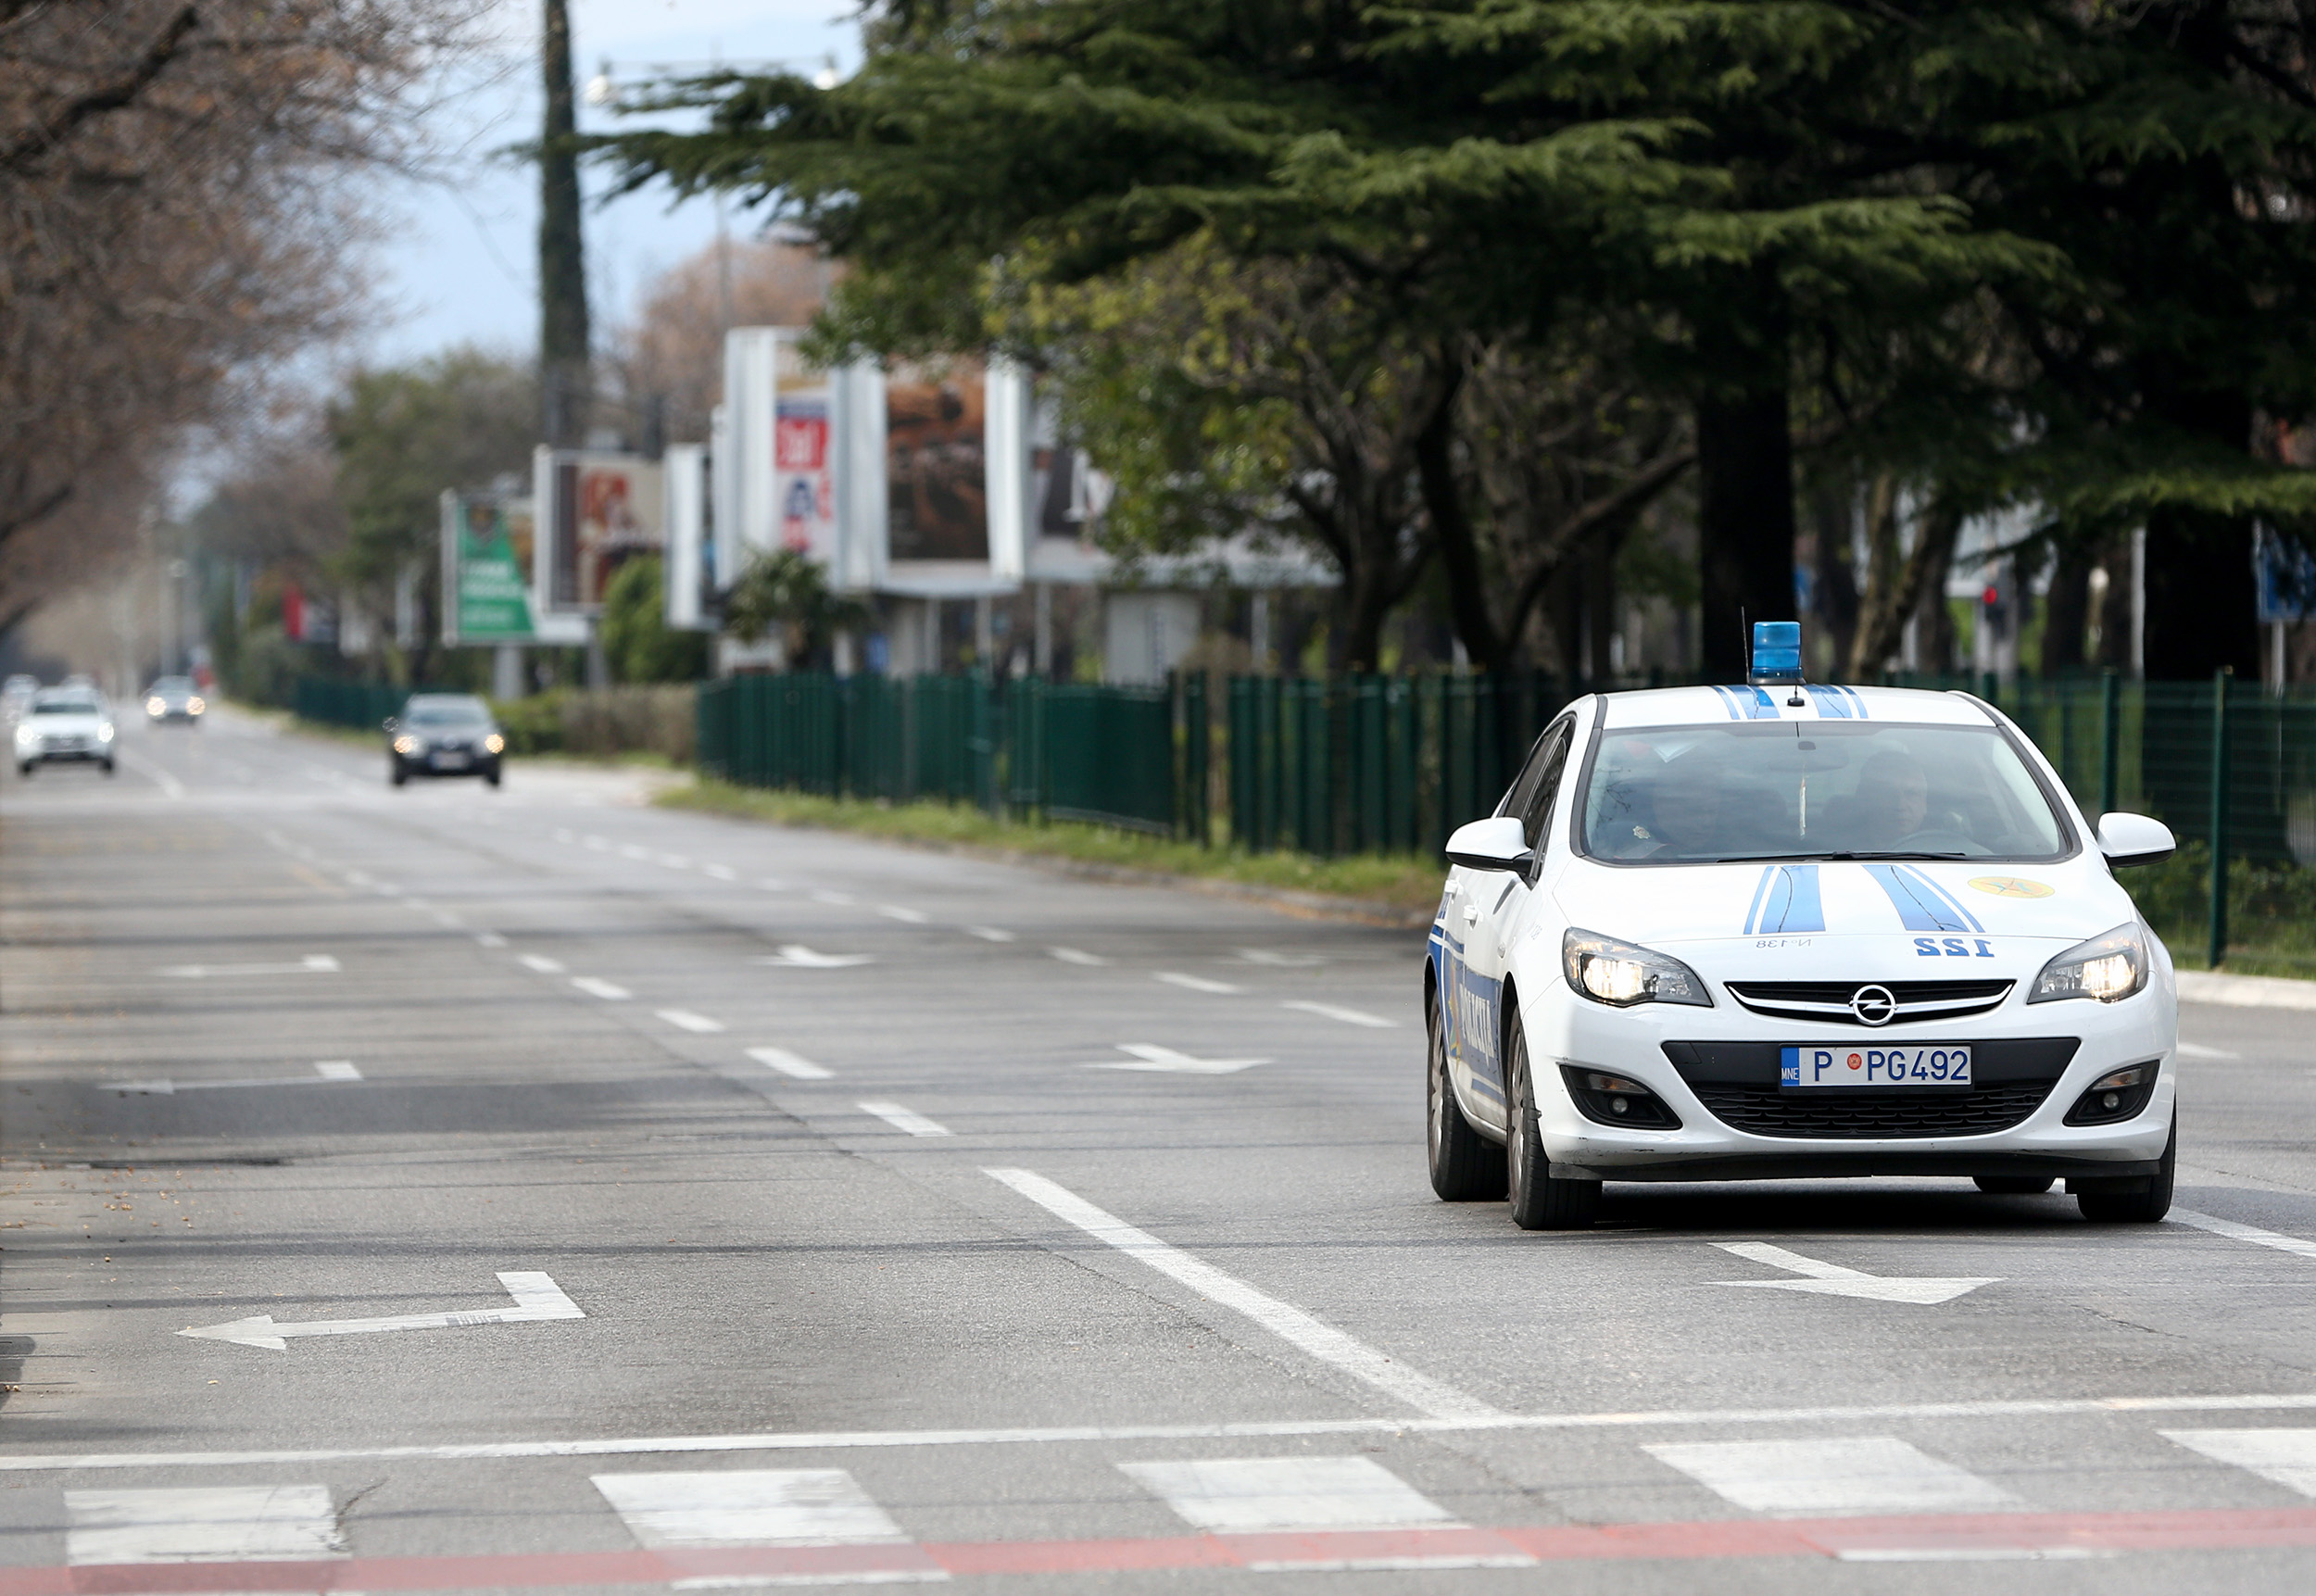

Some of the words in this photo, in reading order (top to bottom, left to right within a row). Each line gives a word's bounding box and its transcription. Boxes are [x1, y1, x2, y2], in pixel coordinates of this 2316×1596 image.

[1781, 1067, 1800, 1081] MNE
[1814, 1051, 1832, 1082] P
[1867, 1050, 1969, 1081] PG492
